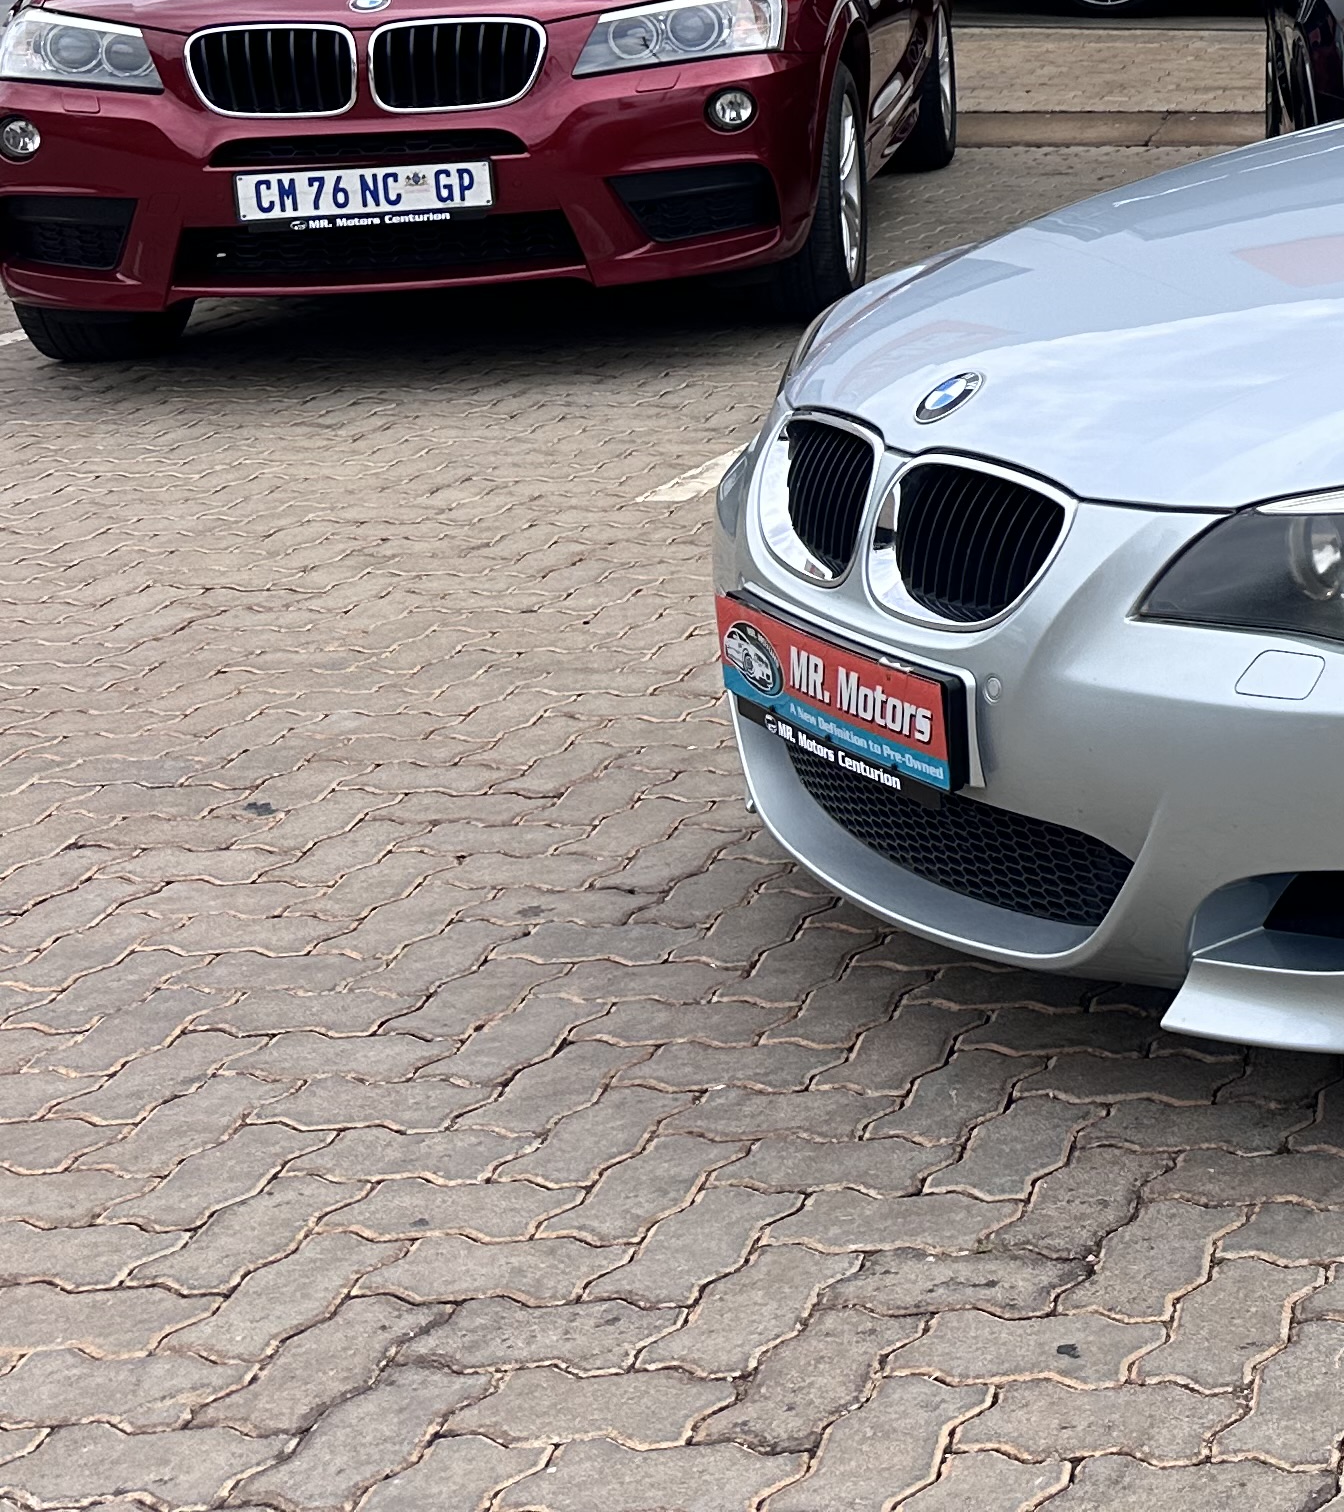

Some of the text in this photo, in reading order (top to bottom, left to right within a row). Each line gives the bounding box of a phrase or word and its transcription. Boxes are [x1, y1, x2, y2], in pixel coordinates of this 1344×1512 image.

[254, 168, 475, 213] CM 76 NC GP
[309, 212, 451, 229] MR. Motors Centurion
[789, 645, 830, 705] MR.
[836, 665, 933, 743] Motors
[777, 720, 902, 790] MR. Motors Centurion
[789, 702, 797, 716] A
[817, 715, 868, 749] Definition
[868, 739, 882, 755] to
[882, 744, 944, 780] Pre-Owned
